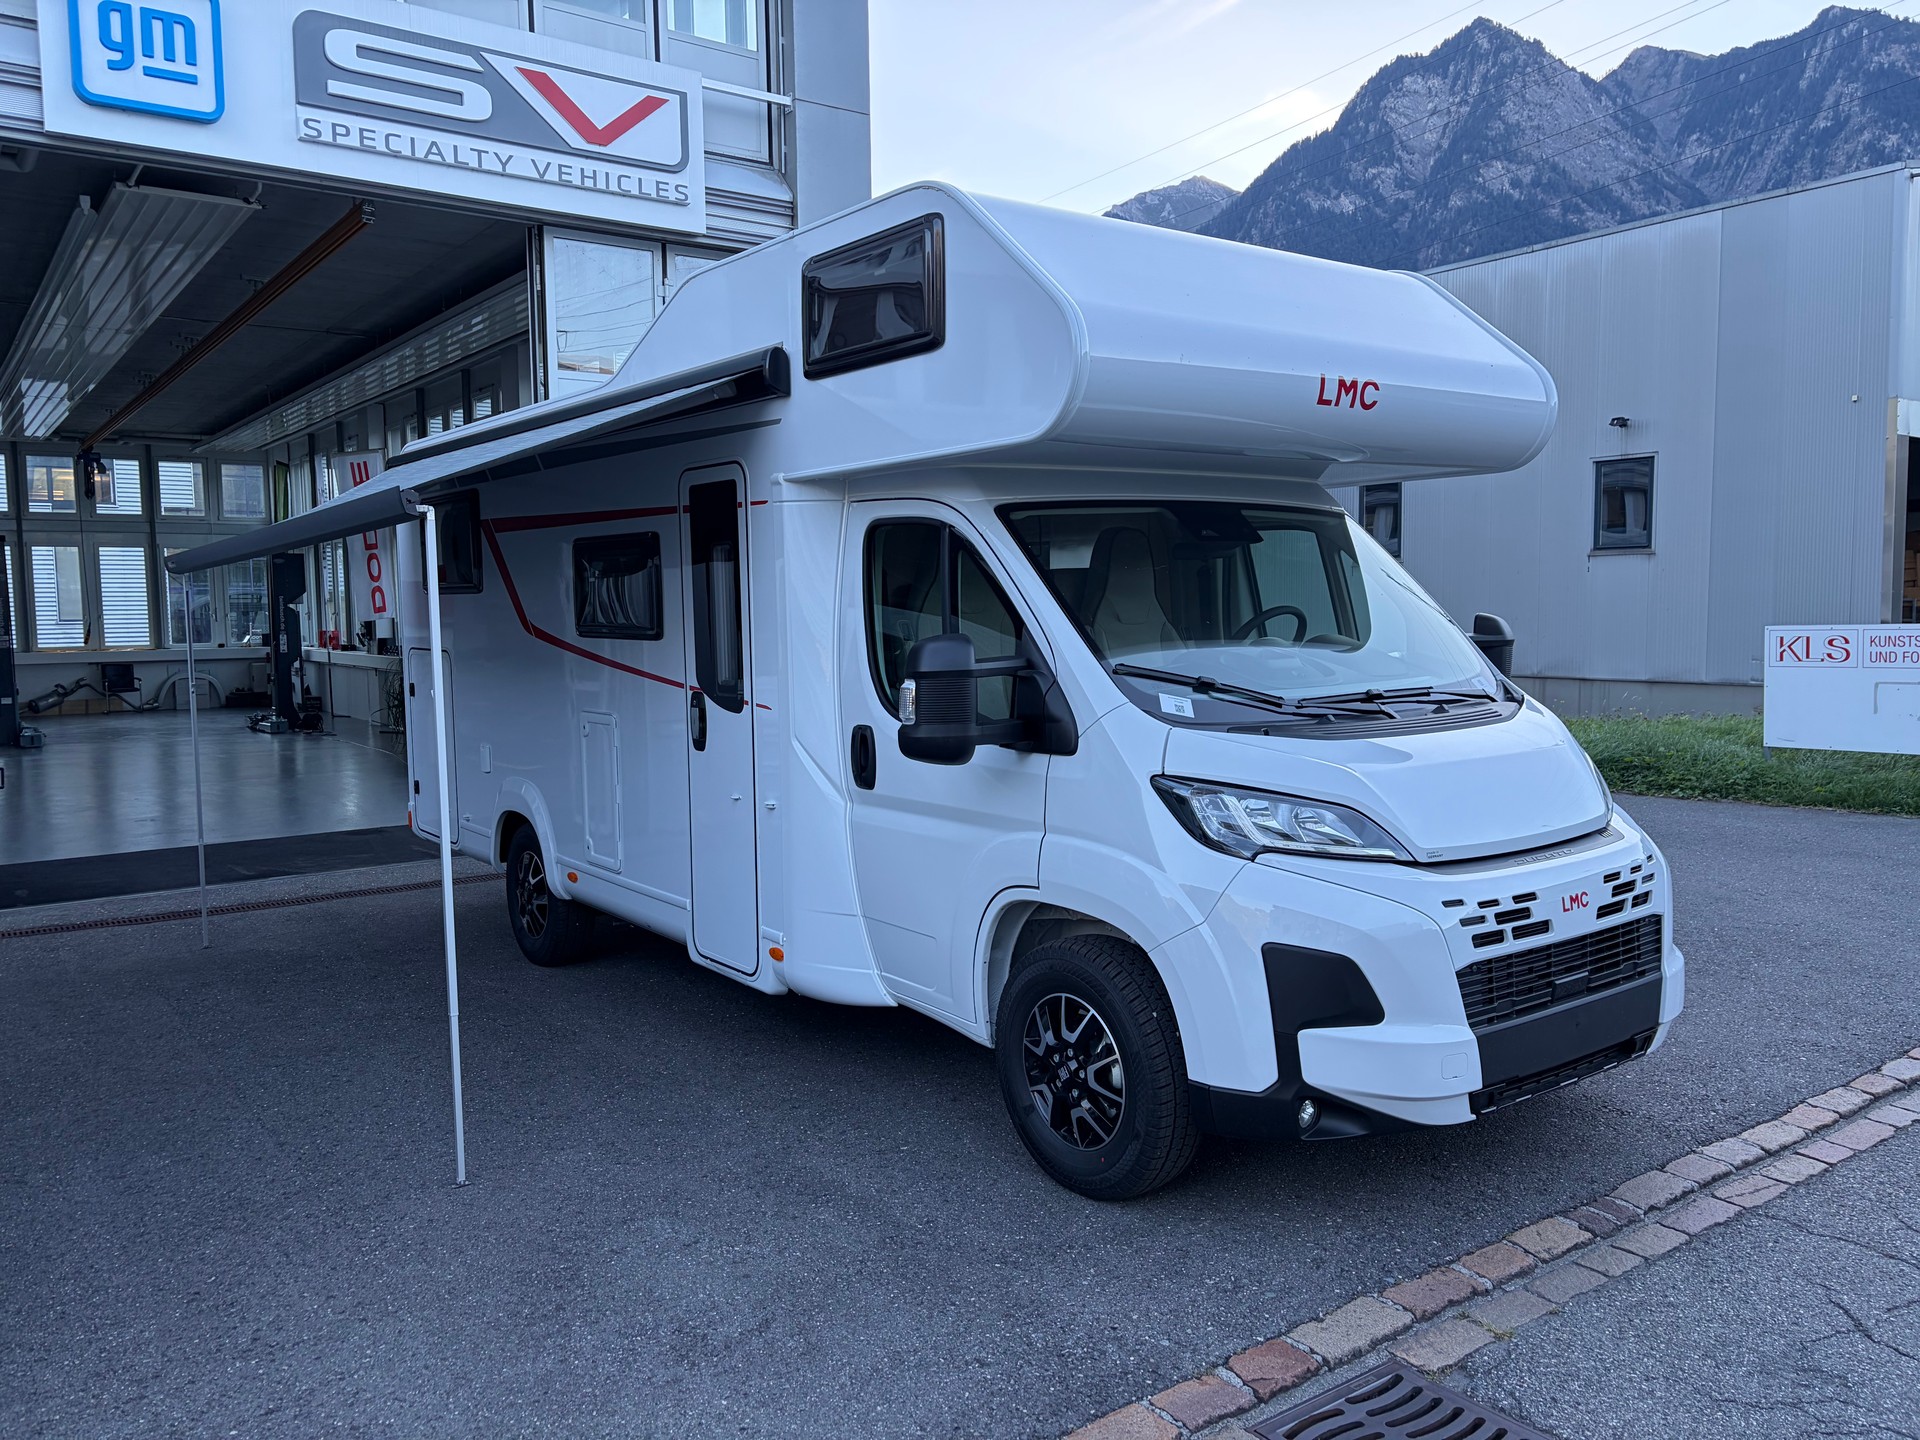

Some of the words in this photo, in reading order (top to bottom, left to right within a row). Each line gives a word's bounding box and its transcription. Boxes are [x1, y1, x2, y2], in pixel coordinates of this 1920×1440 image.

[97, 0, 198, 72] gm
[323, 28, 670, 147] SV
[302, 117, 514, 173] SPECIALTY
[520, 158, 690, 202] VEHICLES
[1316, 373, 1380, 411] LMC
[349, 460, 387, 614] DODE
[1775, 634, 1851, 663] KLS
[1869, 635, 1920, 648] KUNSTS
[1869, 650, 1898, 664] UND
[1902, 650, 1920, 664] FO
[1561, 891, 1590, 913] LMC
